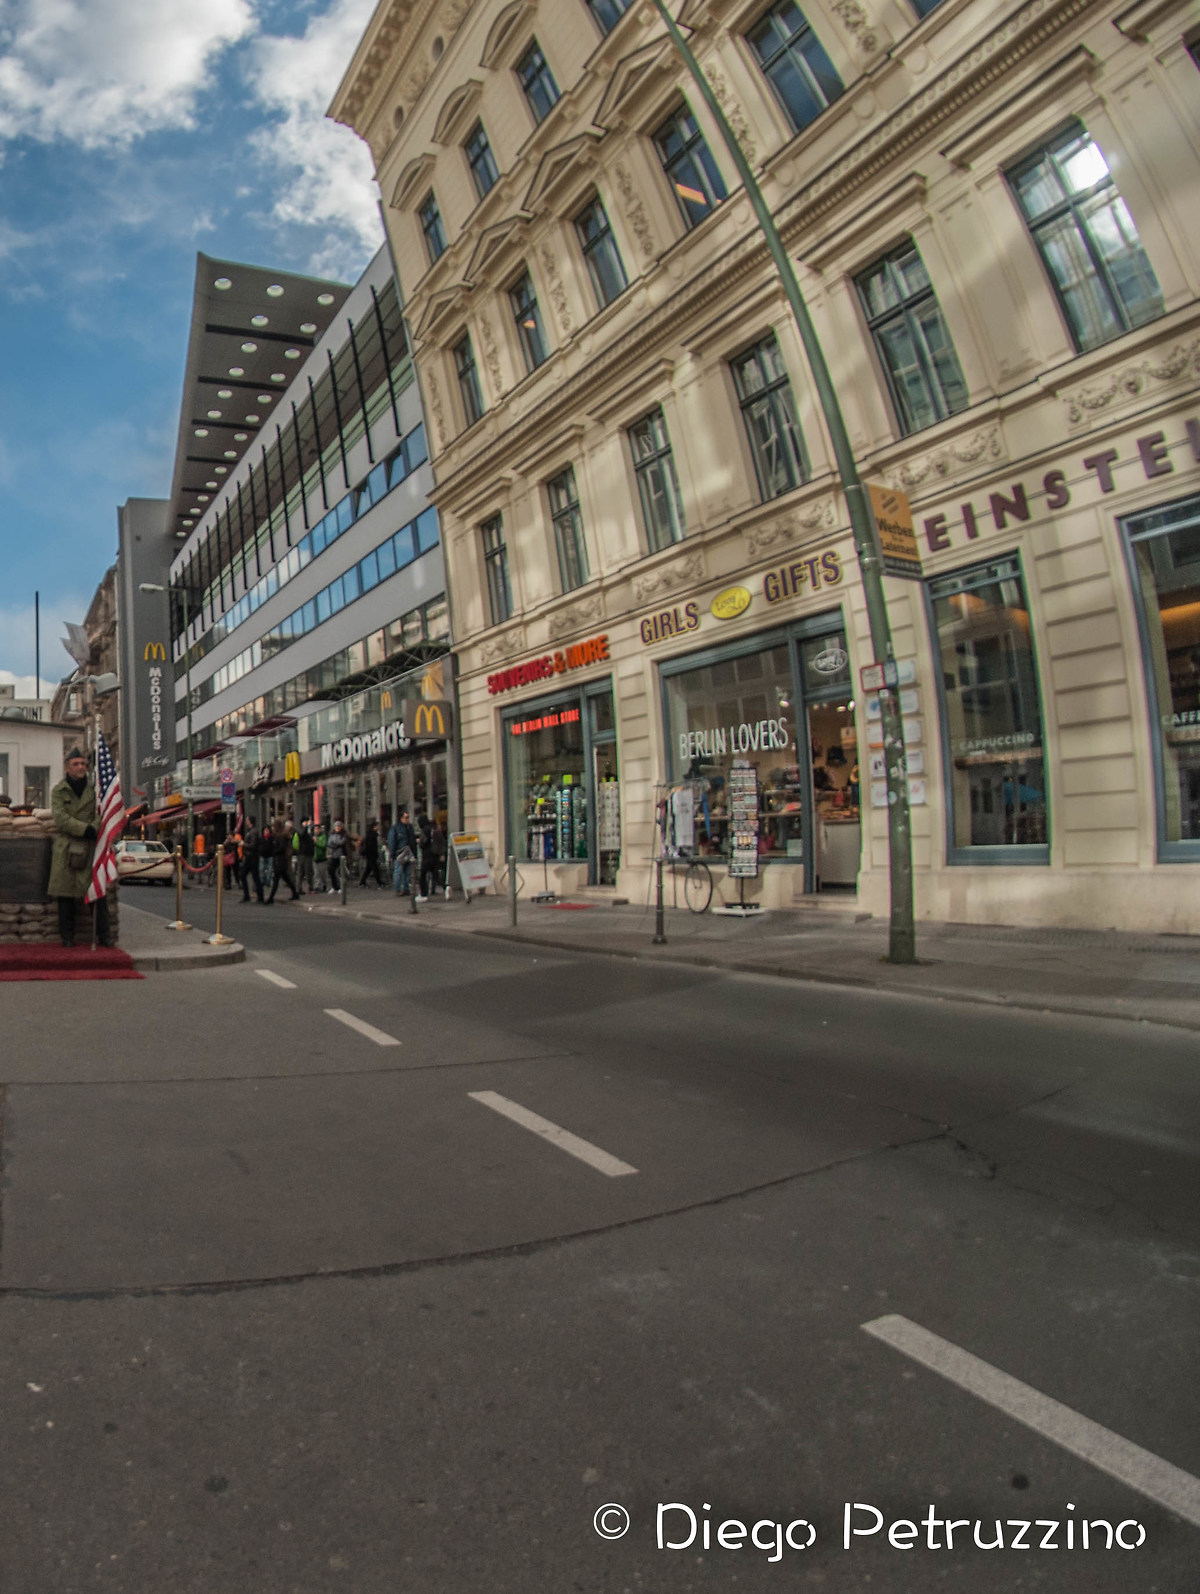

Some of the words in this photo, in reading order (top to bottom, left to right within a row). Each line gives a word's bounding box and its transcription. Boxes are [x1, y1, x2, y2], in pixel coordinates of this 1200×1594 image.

[640, 602, 699, 645] GIRLS
[763, 550, 843, 605] GIFTS
[487, 655, 553, 695] SOUVENIRS
[553, 651, 566, 674] &
[565, 634, 611, 670] MORE
[321, 721, 411, 768] McDonald's
[679, 727, 726, 760] BERLIN
[959, 732, 1035, 750] CAPPUCCINO
